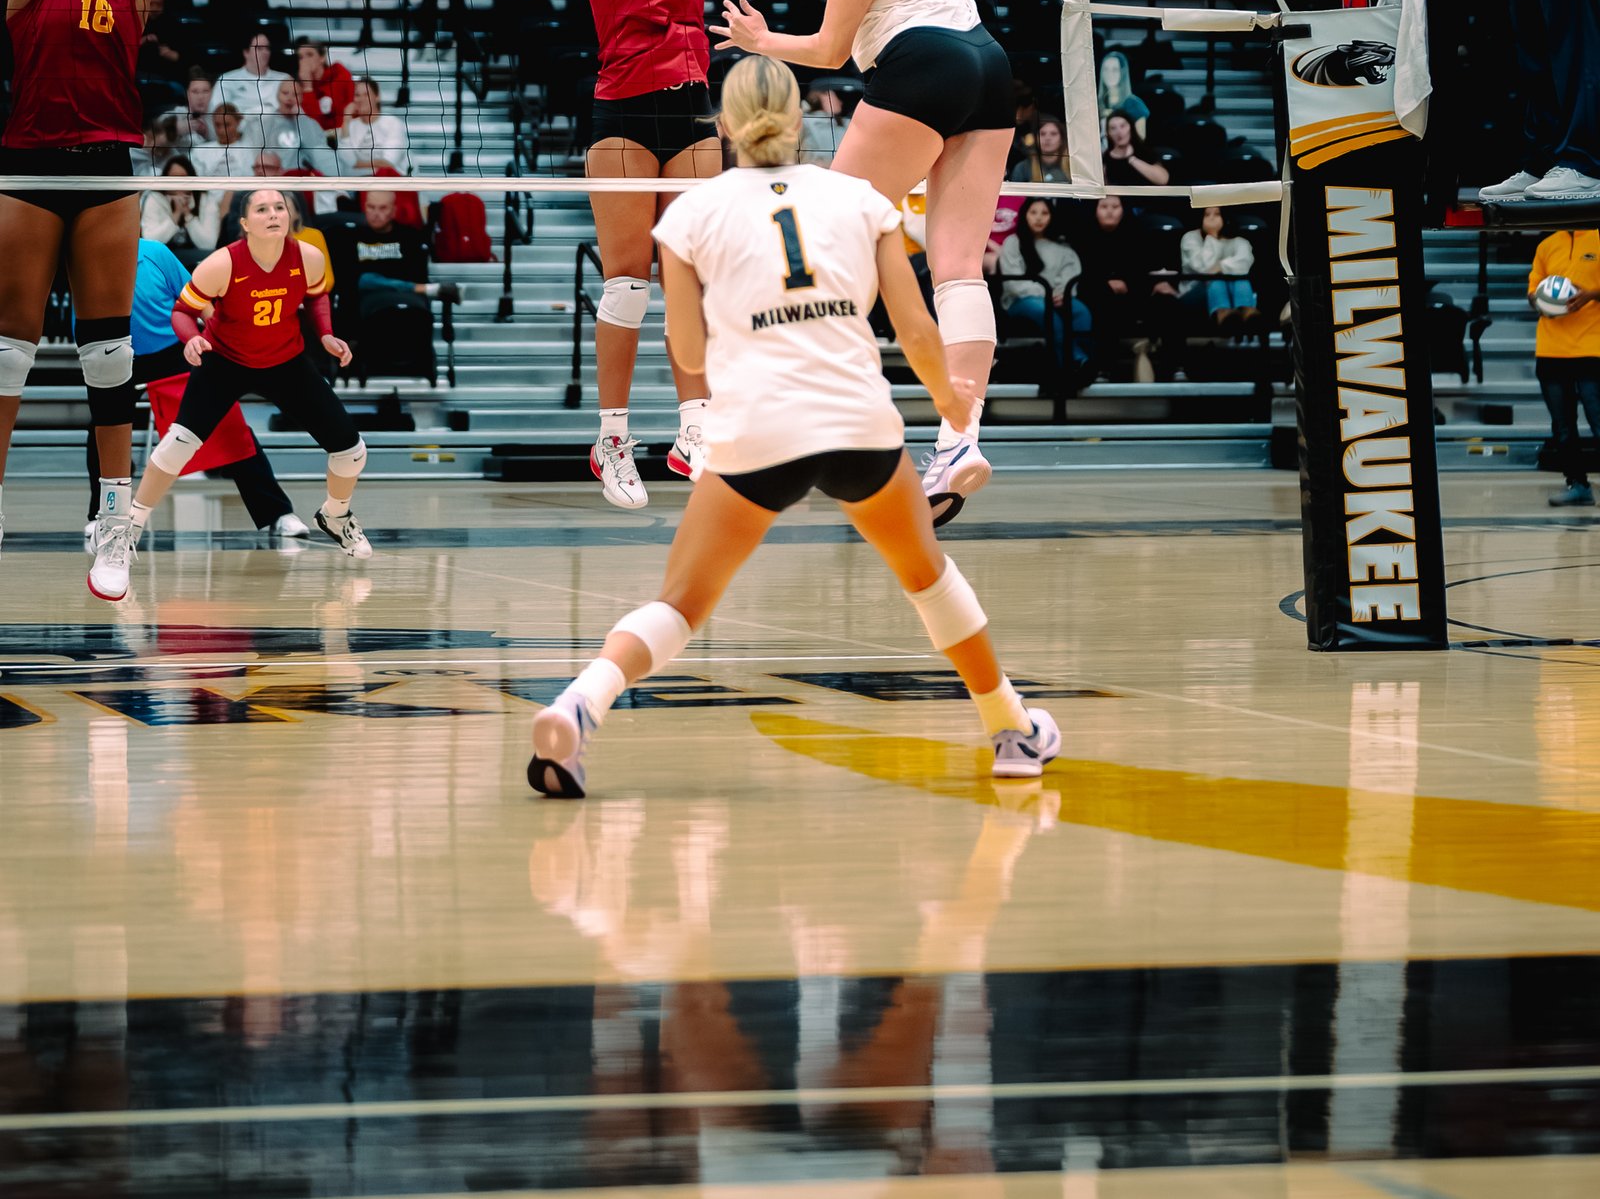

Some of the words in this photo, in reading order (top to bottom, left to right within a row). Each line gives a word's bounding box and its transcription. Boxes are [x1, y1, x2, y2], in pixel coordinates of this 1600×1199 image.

[770, 205, 817, 292] 1
[253, 299, 283, 326] 21
[751, 300, 858, 331] MILWAUKEE
[1324, 185, 1421, 623] MILWAUKEE
